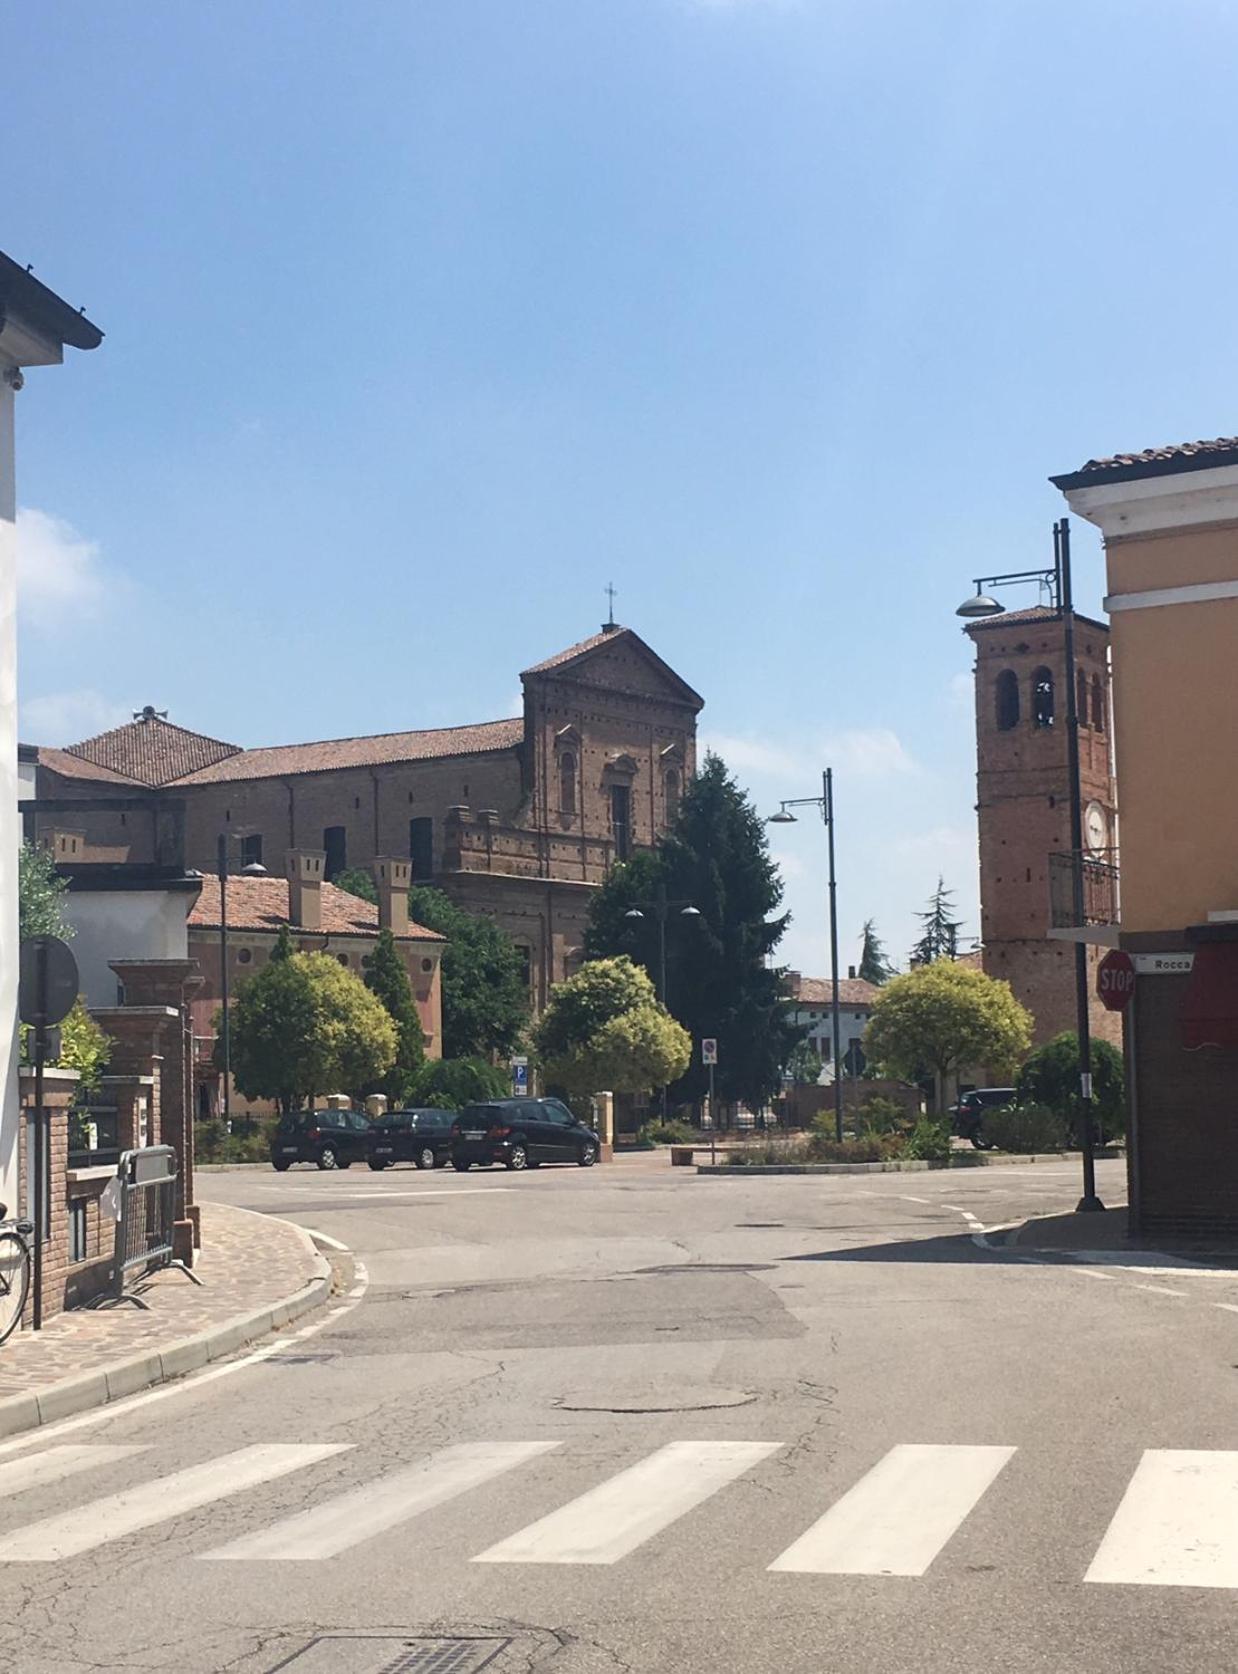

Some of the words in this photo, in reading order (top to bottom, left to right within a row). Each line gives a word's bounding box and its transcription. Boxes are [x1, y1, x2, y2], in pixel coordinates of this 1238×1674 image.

[1155, 960, 1190, 969] Rocca
[1101, 969, 1133, 991] STOP
[517, 1066, 524, 1079] P
